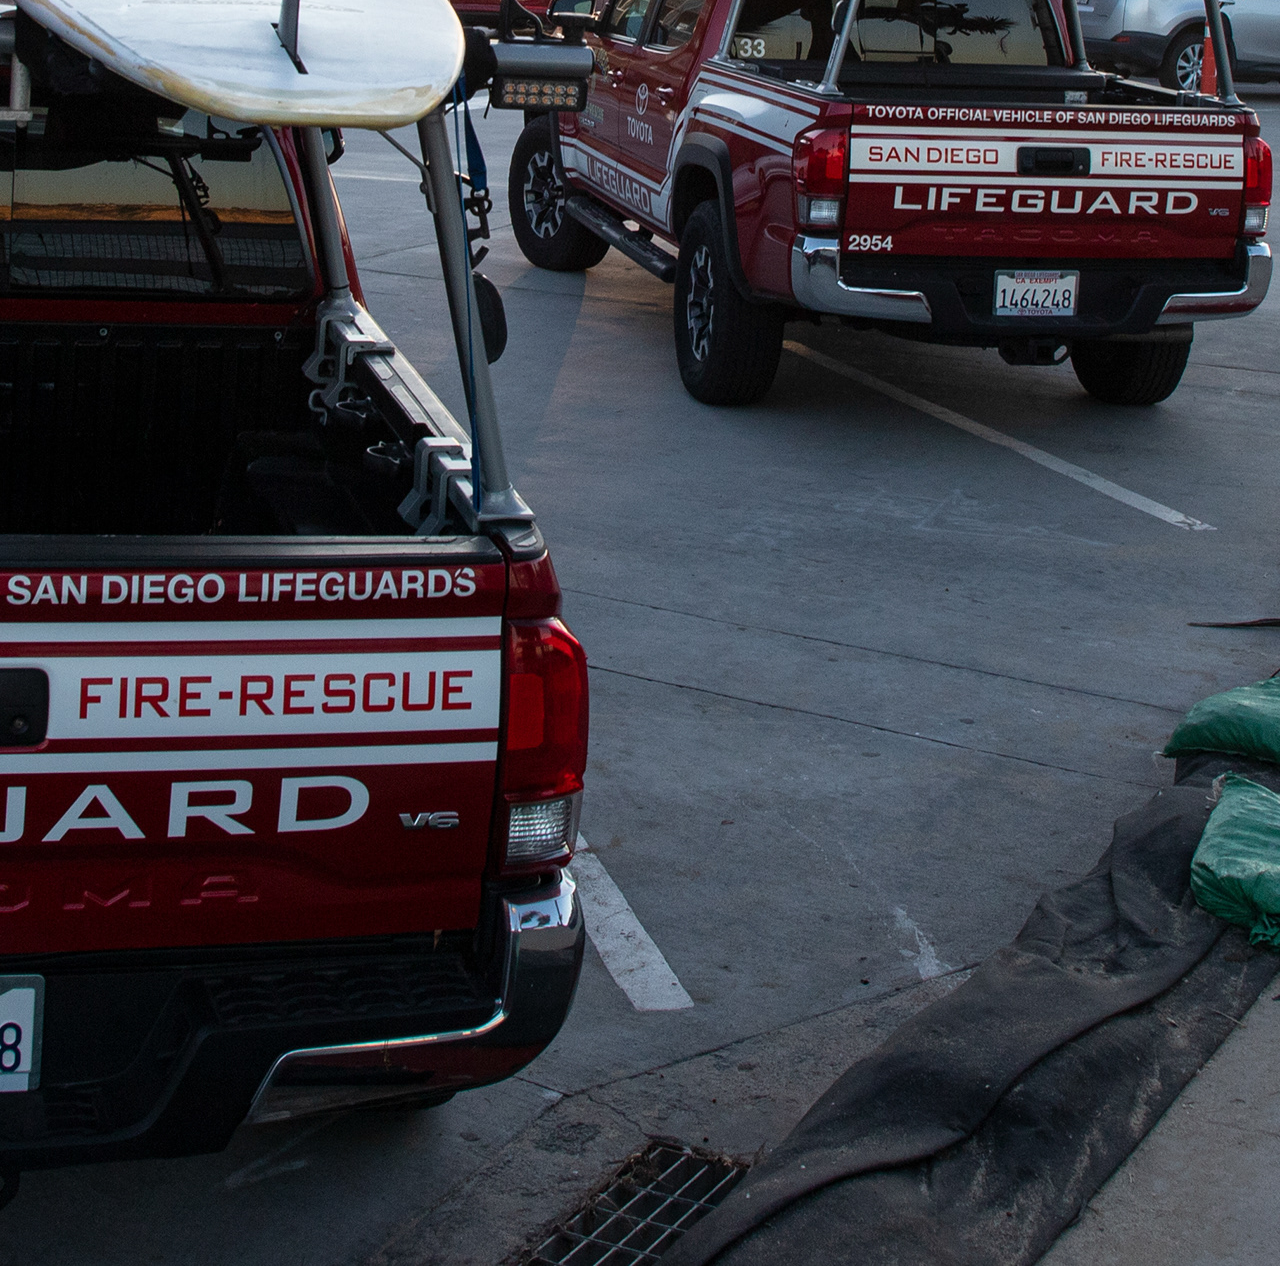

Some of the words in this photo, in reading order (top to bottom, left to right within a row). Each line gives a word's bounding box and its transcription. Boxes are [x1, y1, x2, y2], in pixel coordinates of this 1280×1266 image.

[740, 38, 766, 58] 33
[866, 105, 924, 120] TOYOTA
[927, 108, 990, 122] OFFICIAL
[993, 109, 1052, 123] VEHICLE
[1056, 111, 1075, 124] OF
[1077, 112, 1106, 124] SAN
[1109, 112, 1151, 125] DIEGO
[1154, 113, 1236, 127] LIFEGUARDS
[627, 116, 654, 146] TOYOTA
[868, 146, 920, 163] SAN
[926, 147, 999, 165] DIEGO
[1101, 151, 1235, 169] FIRE-RESCUE
[586, 156, 651, 214] LIFEGUARD
[893, 185, 1199, 215] LIFEGUARD
[848, 234, 893, 251] 2954
[999, 288, 1072, 308] 1464248
[6, 574, 88, 605] SAN
[101, 572, 225, 605] DIEGO
[238, 567, 477, 603] LIFEGUARDS
[79, 670, 474, 720] FIRE-RESCUE
[398, 810, 461, 831] V6
